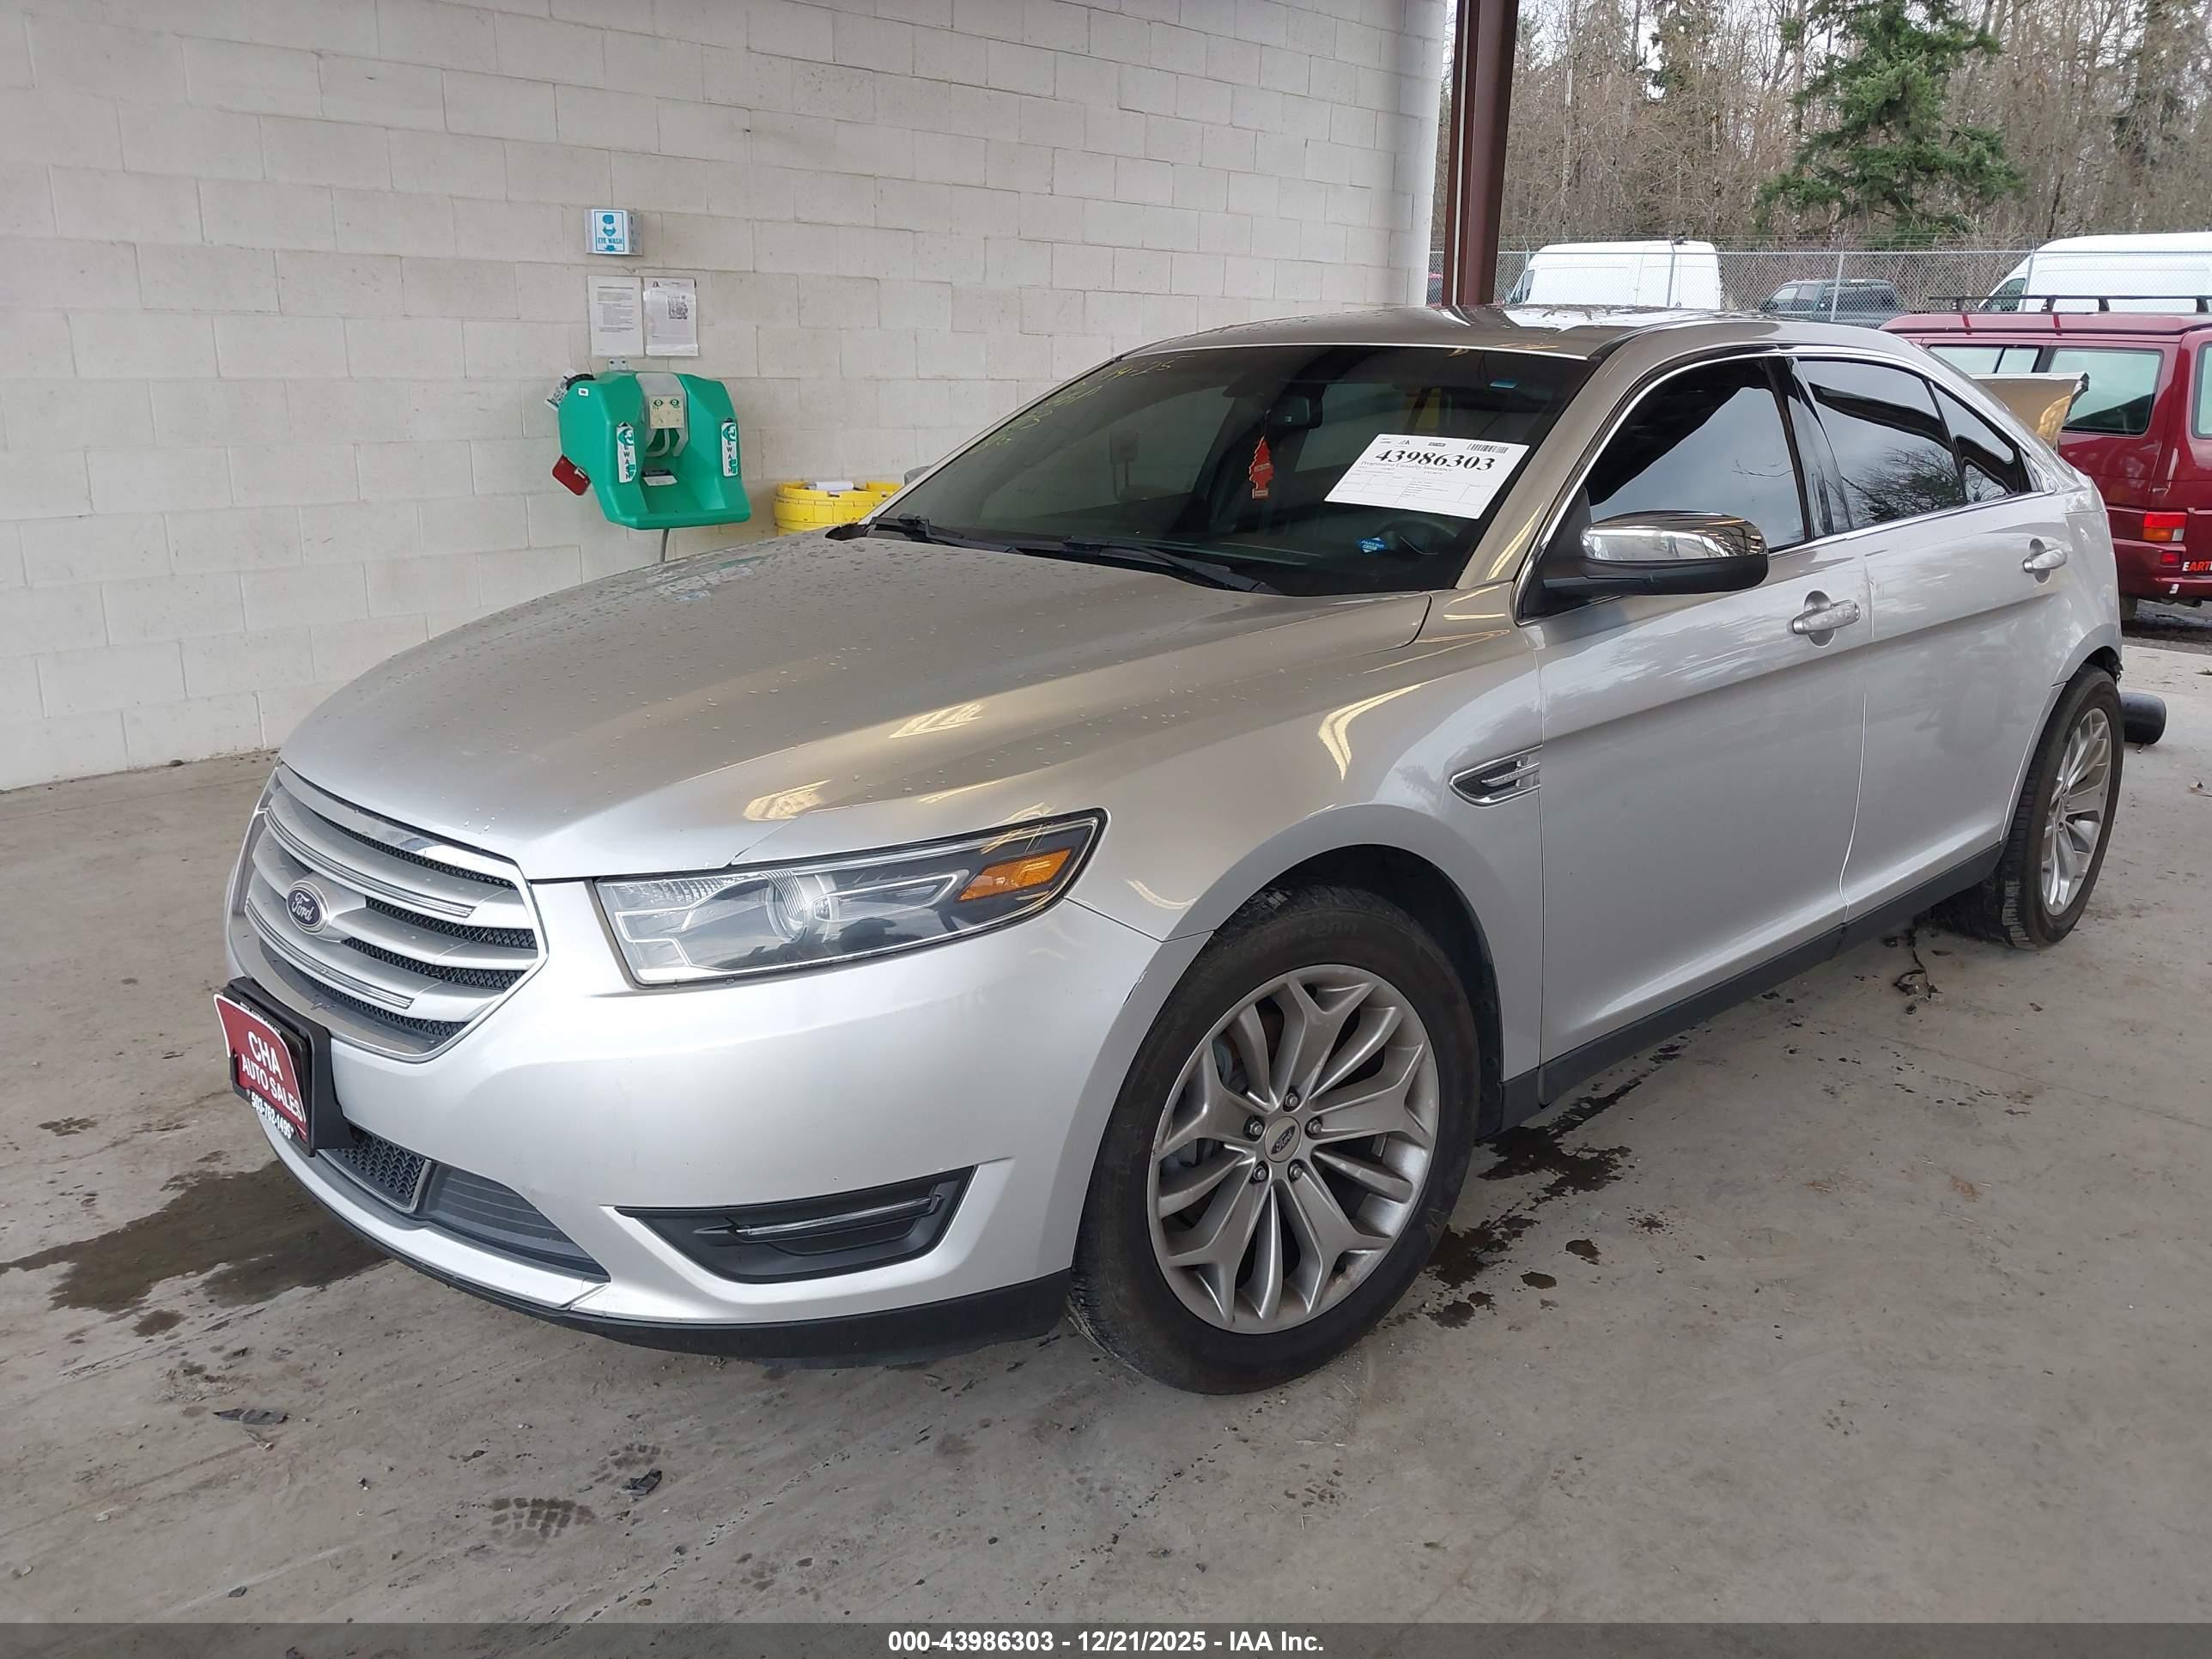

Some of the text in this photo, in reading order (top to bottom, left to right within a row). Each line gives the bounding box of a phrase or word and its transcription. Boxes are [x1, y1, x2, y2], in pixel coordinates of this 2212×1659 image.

[1376, 449, 1496, 471] 43986303
[291, 891, 315, 921] Ford
[248, 1030, 284, 1081] CHA
[241, 1054, 304, 1121] AUTO SALES
[1276, 1130, 1293, 1152] Ford
